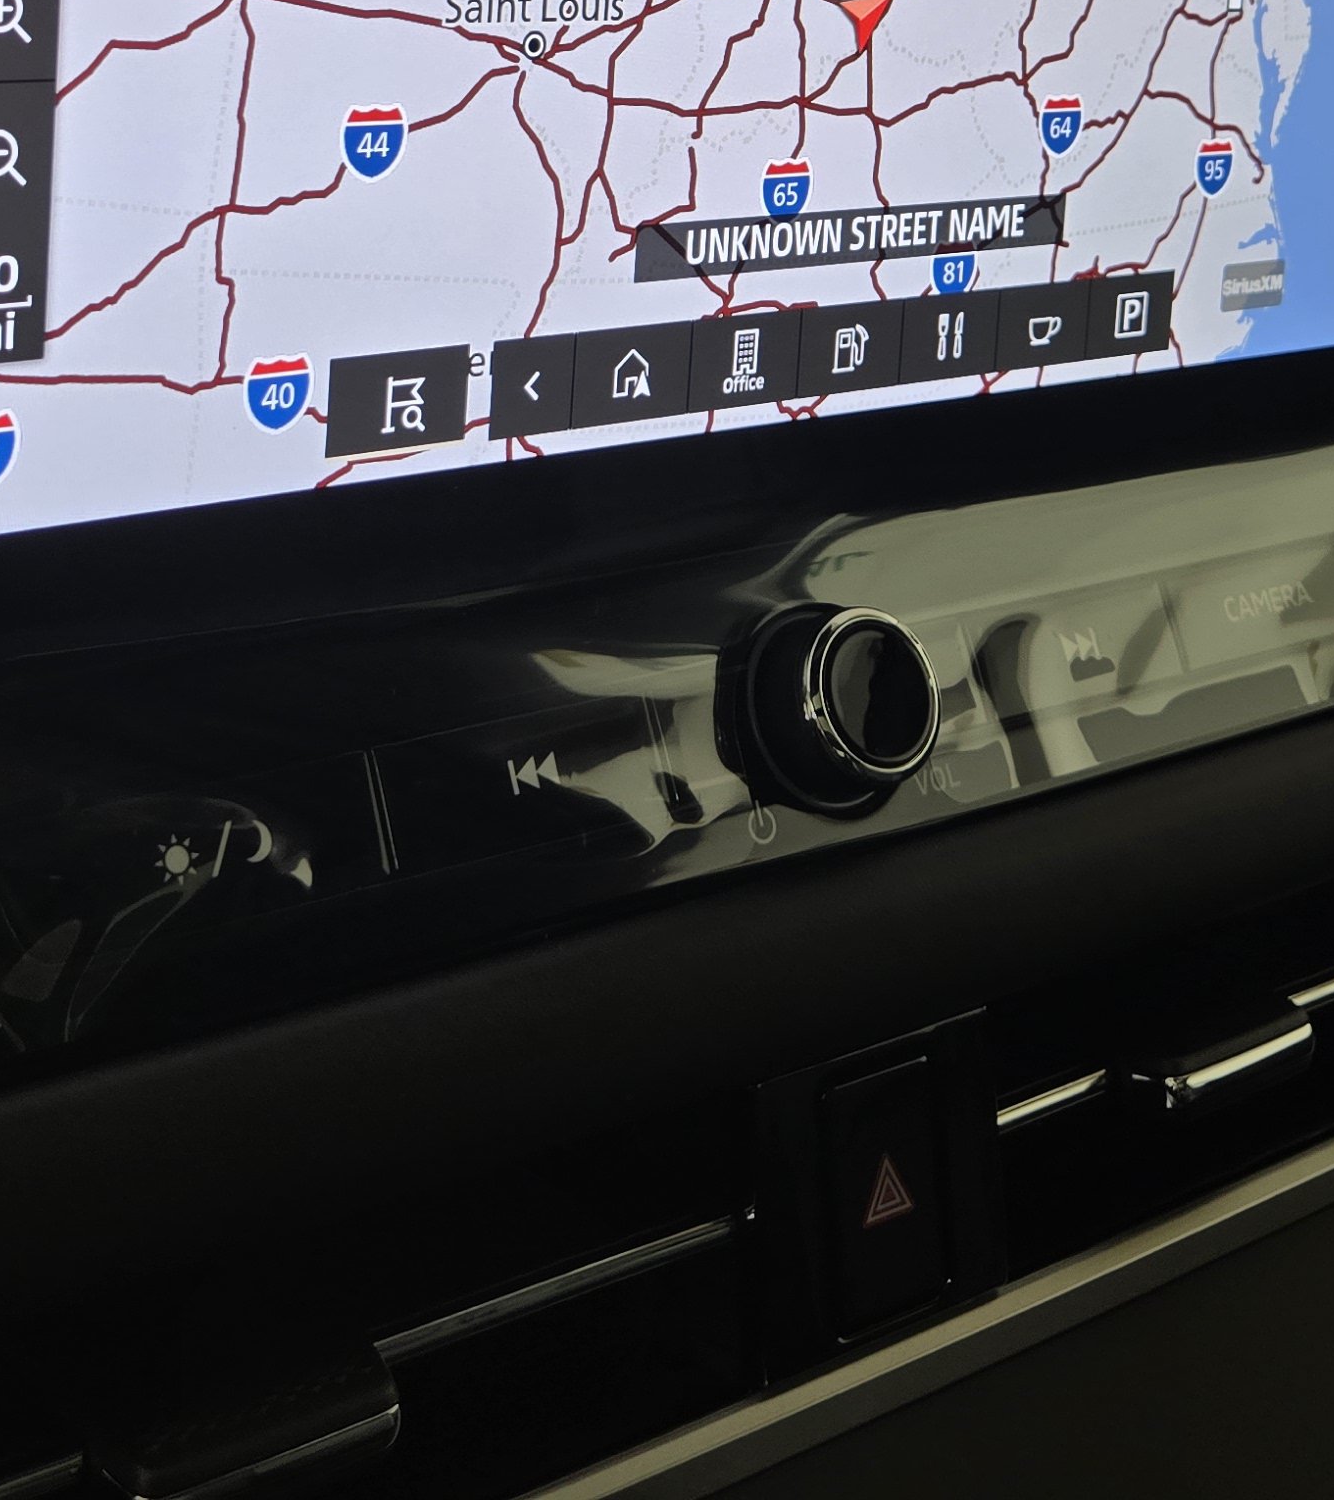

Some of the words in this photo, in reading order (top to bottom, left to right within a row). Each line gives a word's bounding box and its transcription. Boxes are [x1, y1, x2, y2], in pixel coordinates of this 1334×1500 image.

[1049, 117, 1072, 139] 64
[357, 131, 391, 159] 44
[1204, 159, 1225, 181] 95
[772, 182, 799, 207] 65
[685, 218, 844, 266] UNKNOWN
[849, 210, 942, 252] STREET
[947, 203, 1025, 244] NAME
[942, 262, 966, 285] 81
[1222, 273, 1284, 297] SiriusXM
[261, 382, 296, 411] 40
[723, 373, 765, 395] Office
[1223, 579, 1315, 622] CAMERA
[915, 763, 961, 795] VOL
